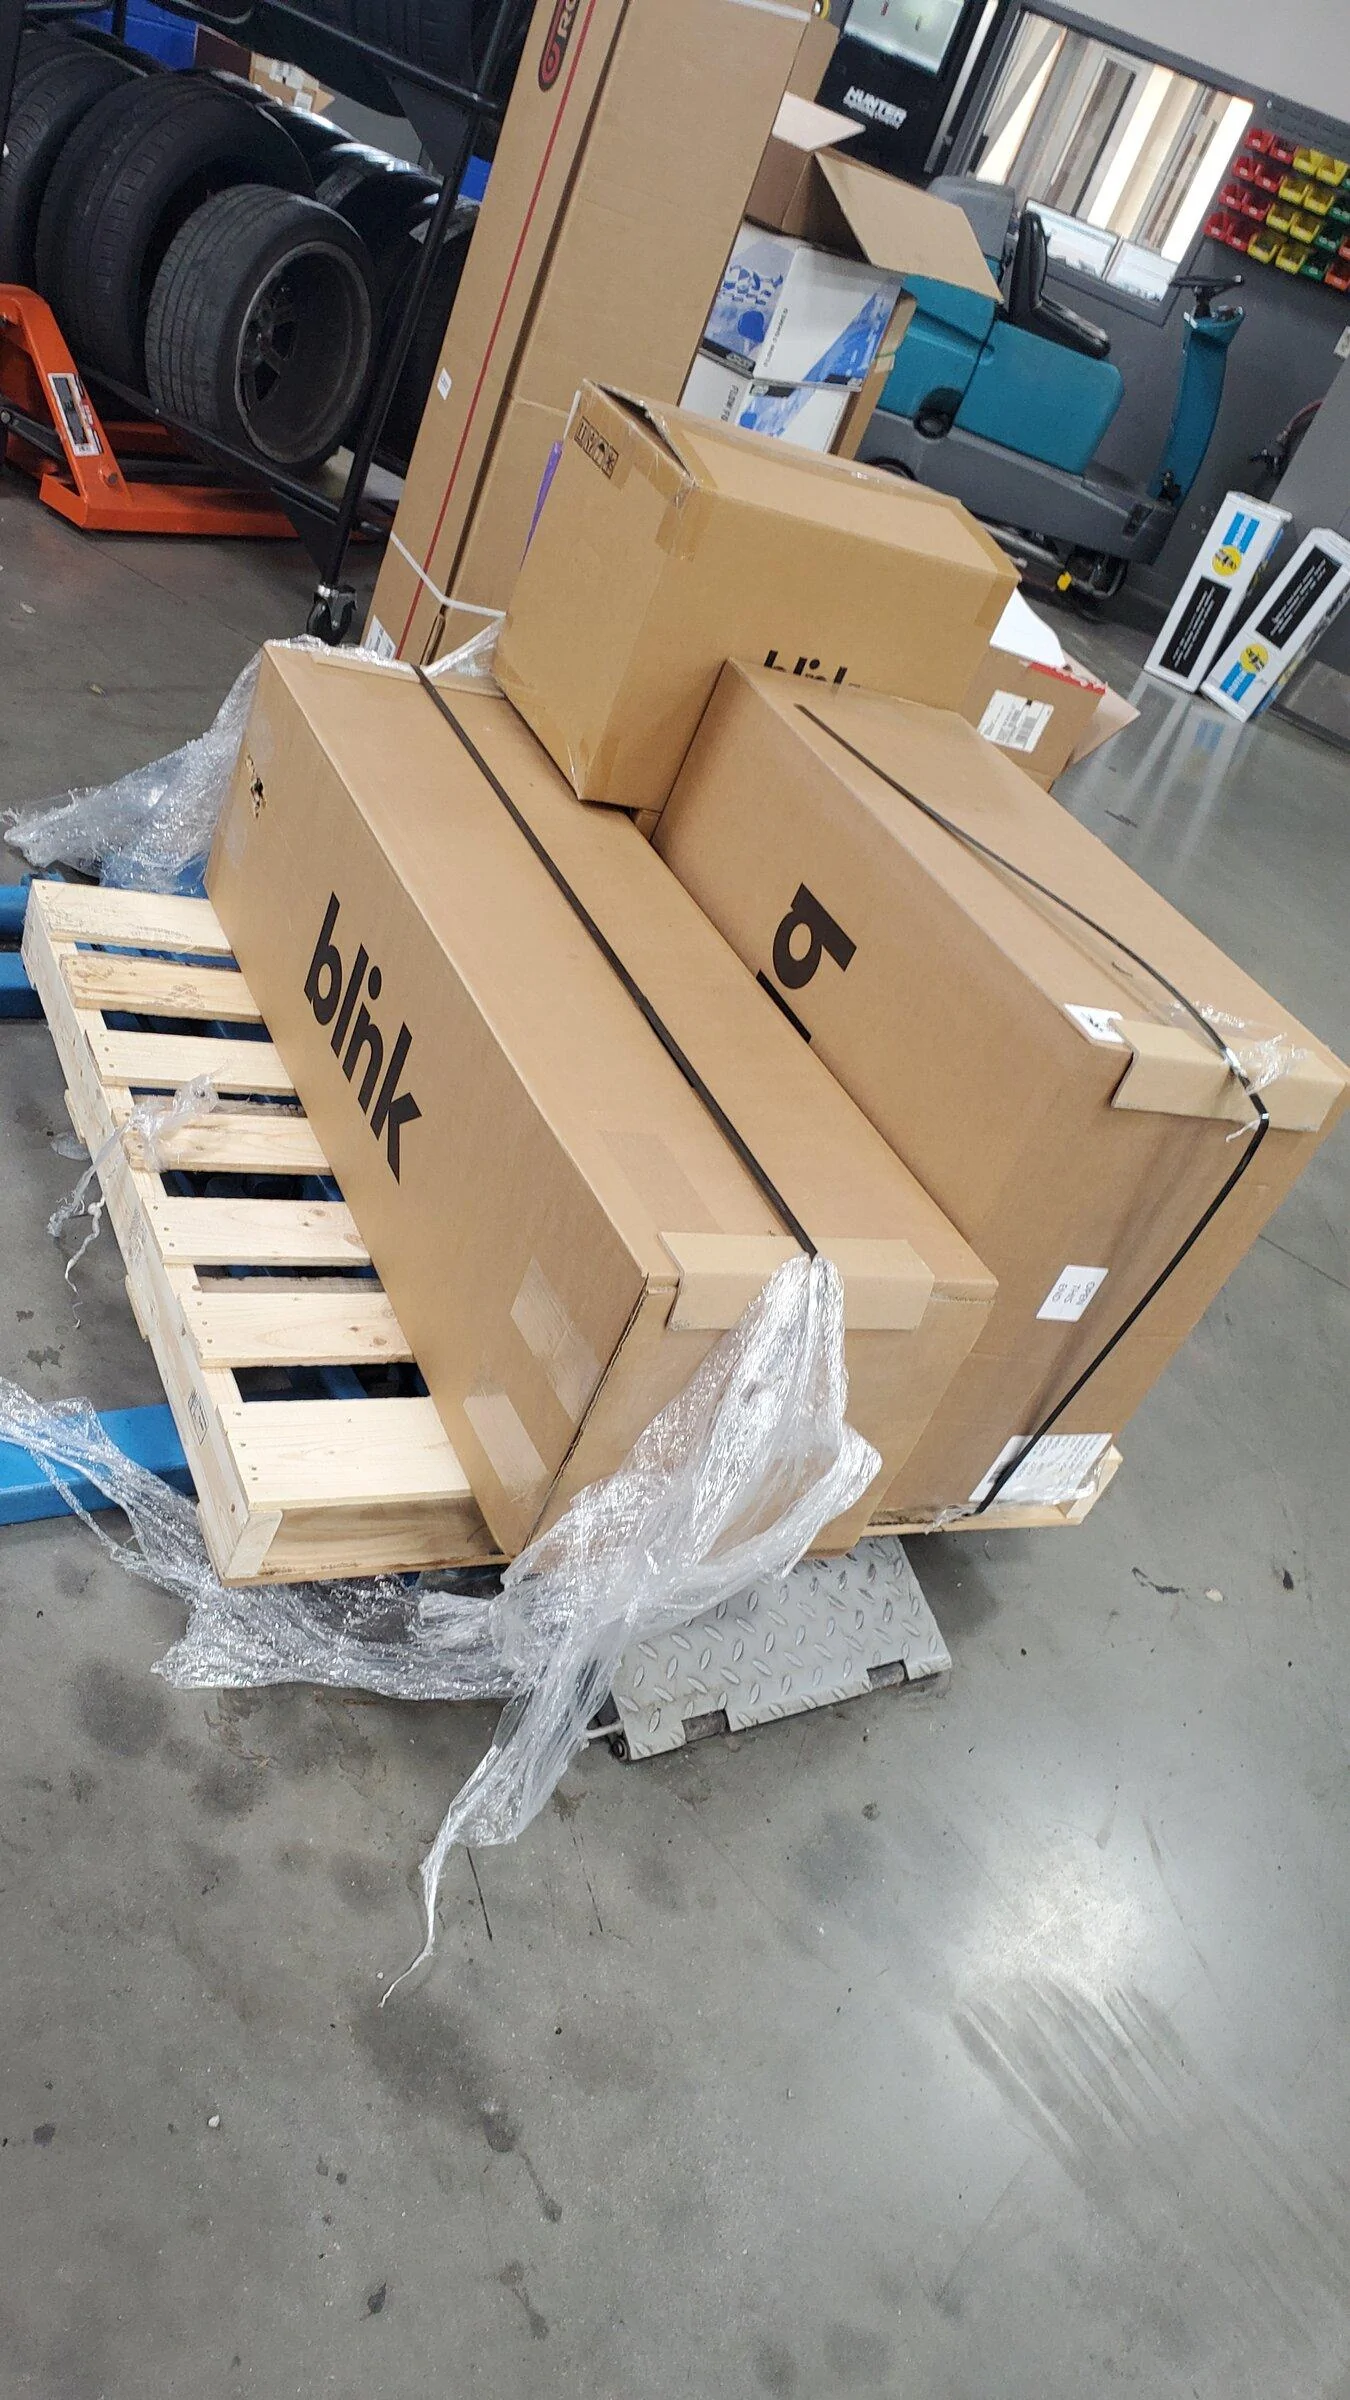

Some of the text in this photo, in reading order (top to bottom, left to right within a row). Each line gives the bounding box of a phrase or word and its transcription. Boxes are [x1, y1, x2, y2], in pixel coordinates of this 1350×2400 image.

[844, 86, 907, 124] HUNTER
[727, 384, 739, 409] FLOW
[304, 891, 422, 1185] blink
